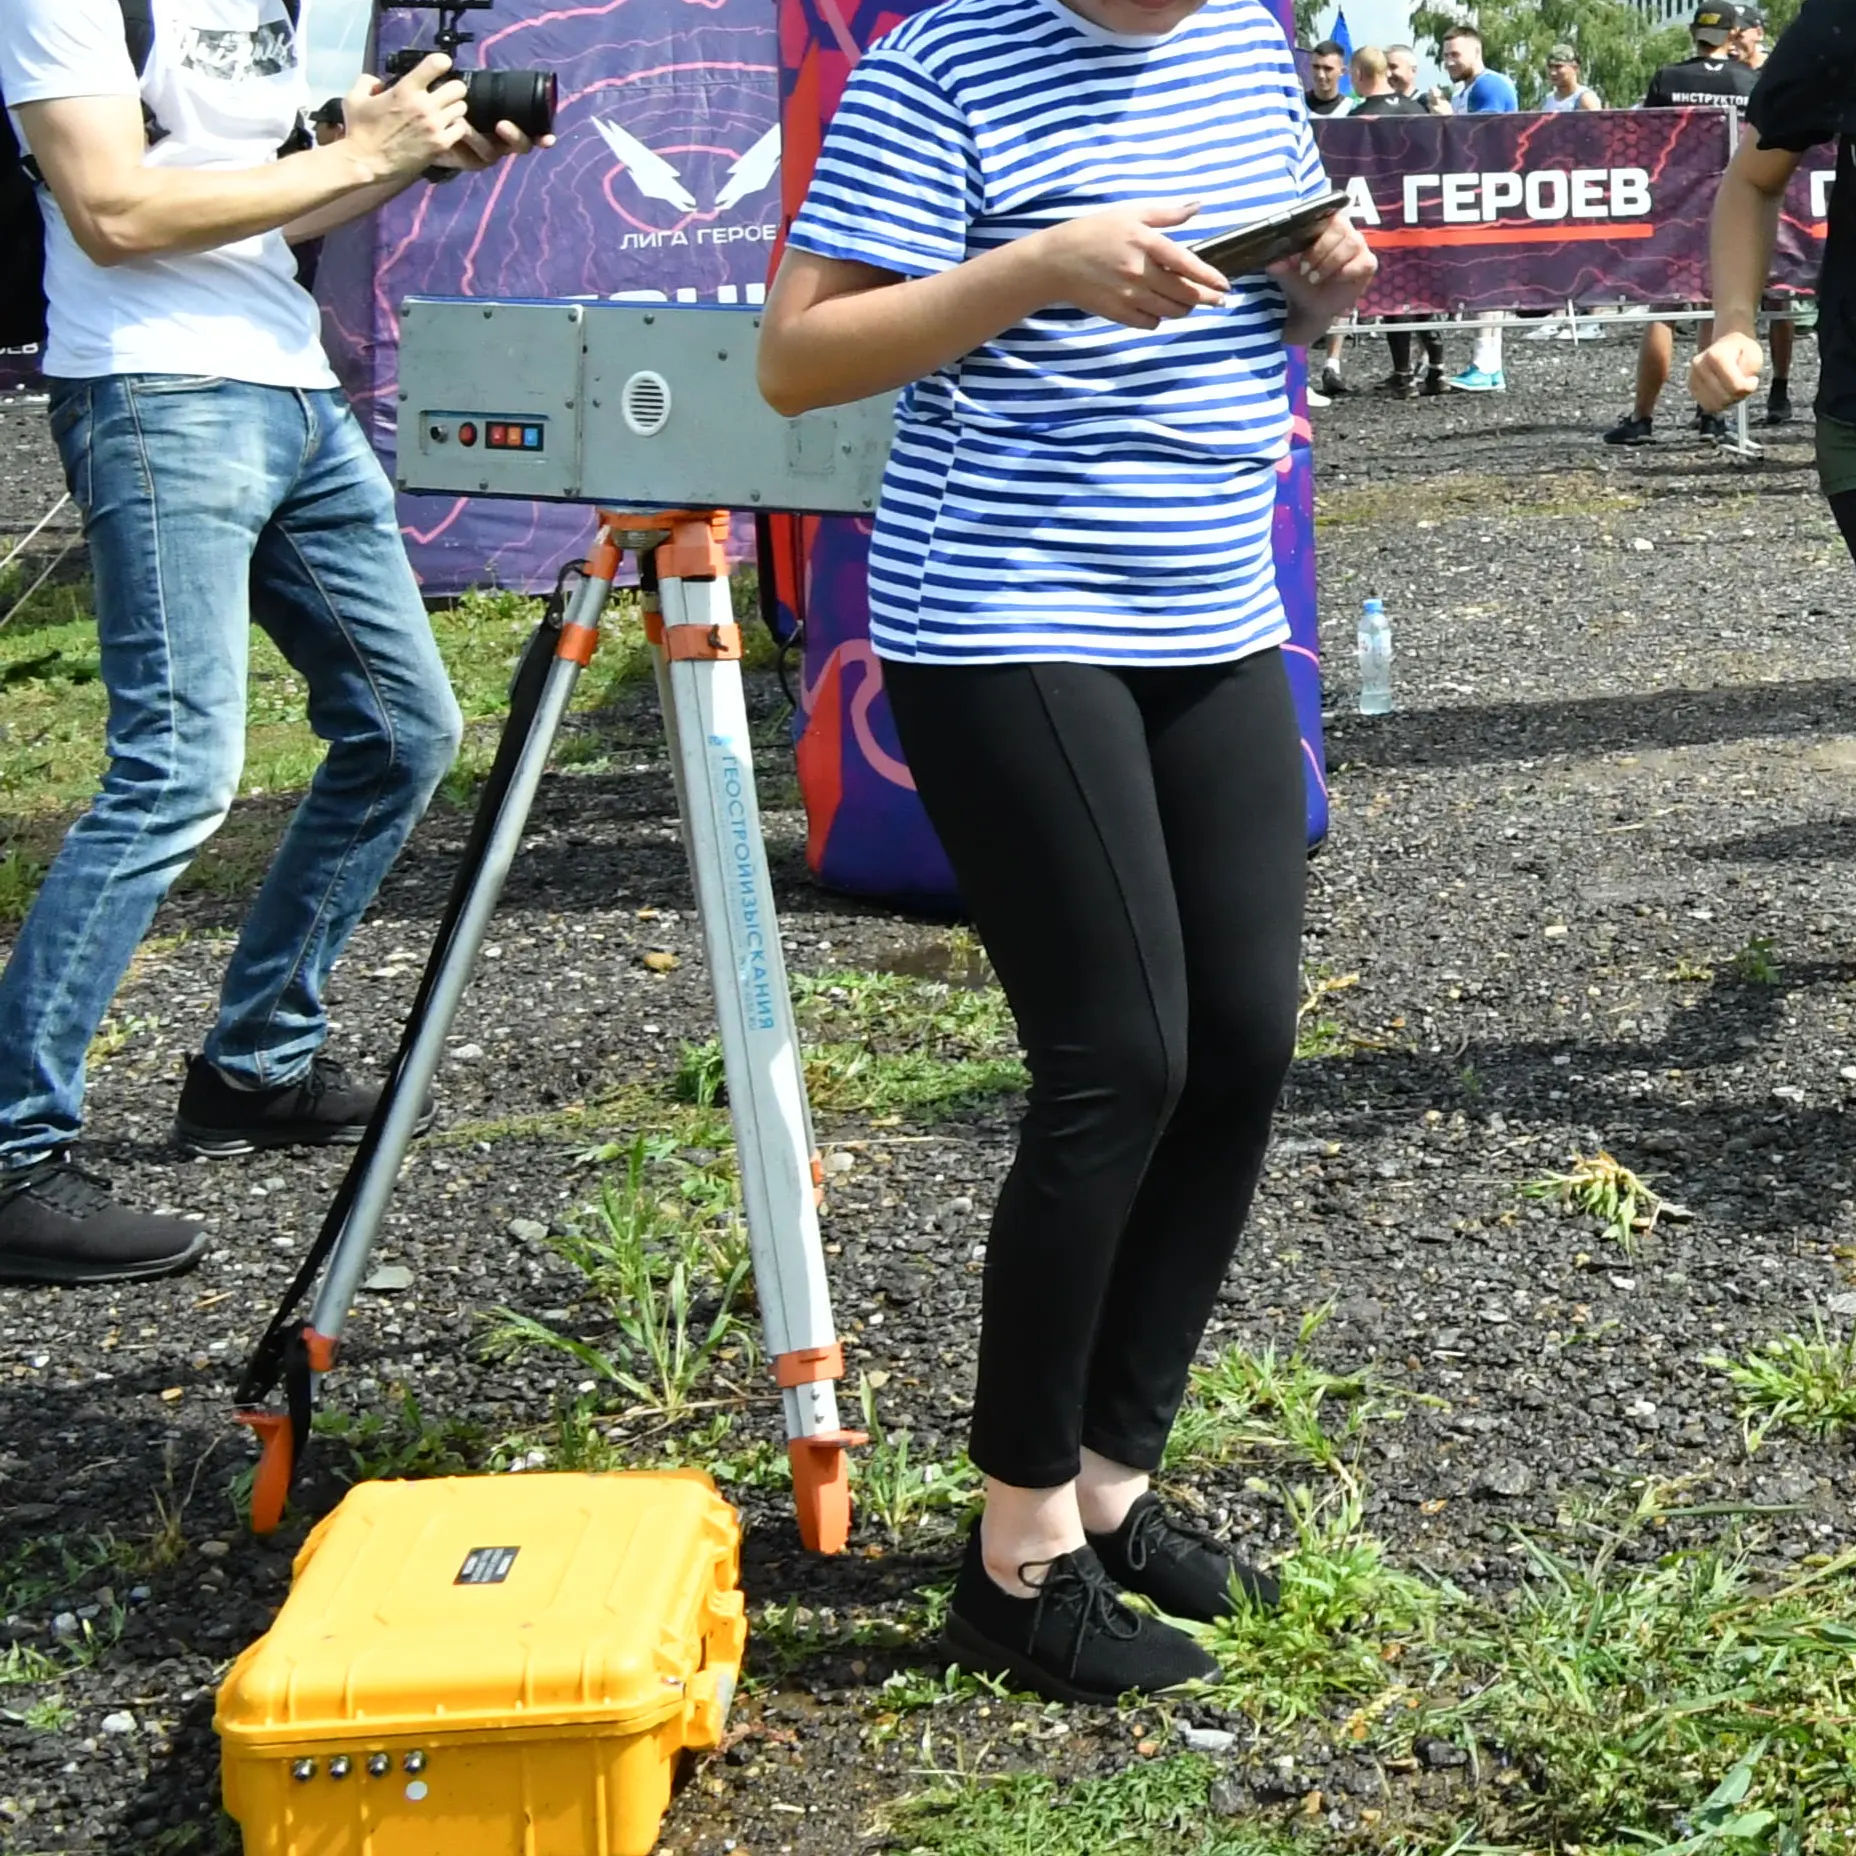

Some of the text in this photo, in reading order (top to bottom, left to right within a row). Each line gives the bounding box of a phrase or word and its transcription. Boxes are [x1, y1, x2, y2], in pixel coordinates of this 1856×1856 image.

[1403, 167, 1653, 224] ГЕРОЕВ
[620, 224, 780, 250] ЛИГА ГЕРОЕ
[721, 755, 775, 1031] ГЕОСТРОЙИЗЫСКАНИЯ
